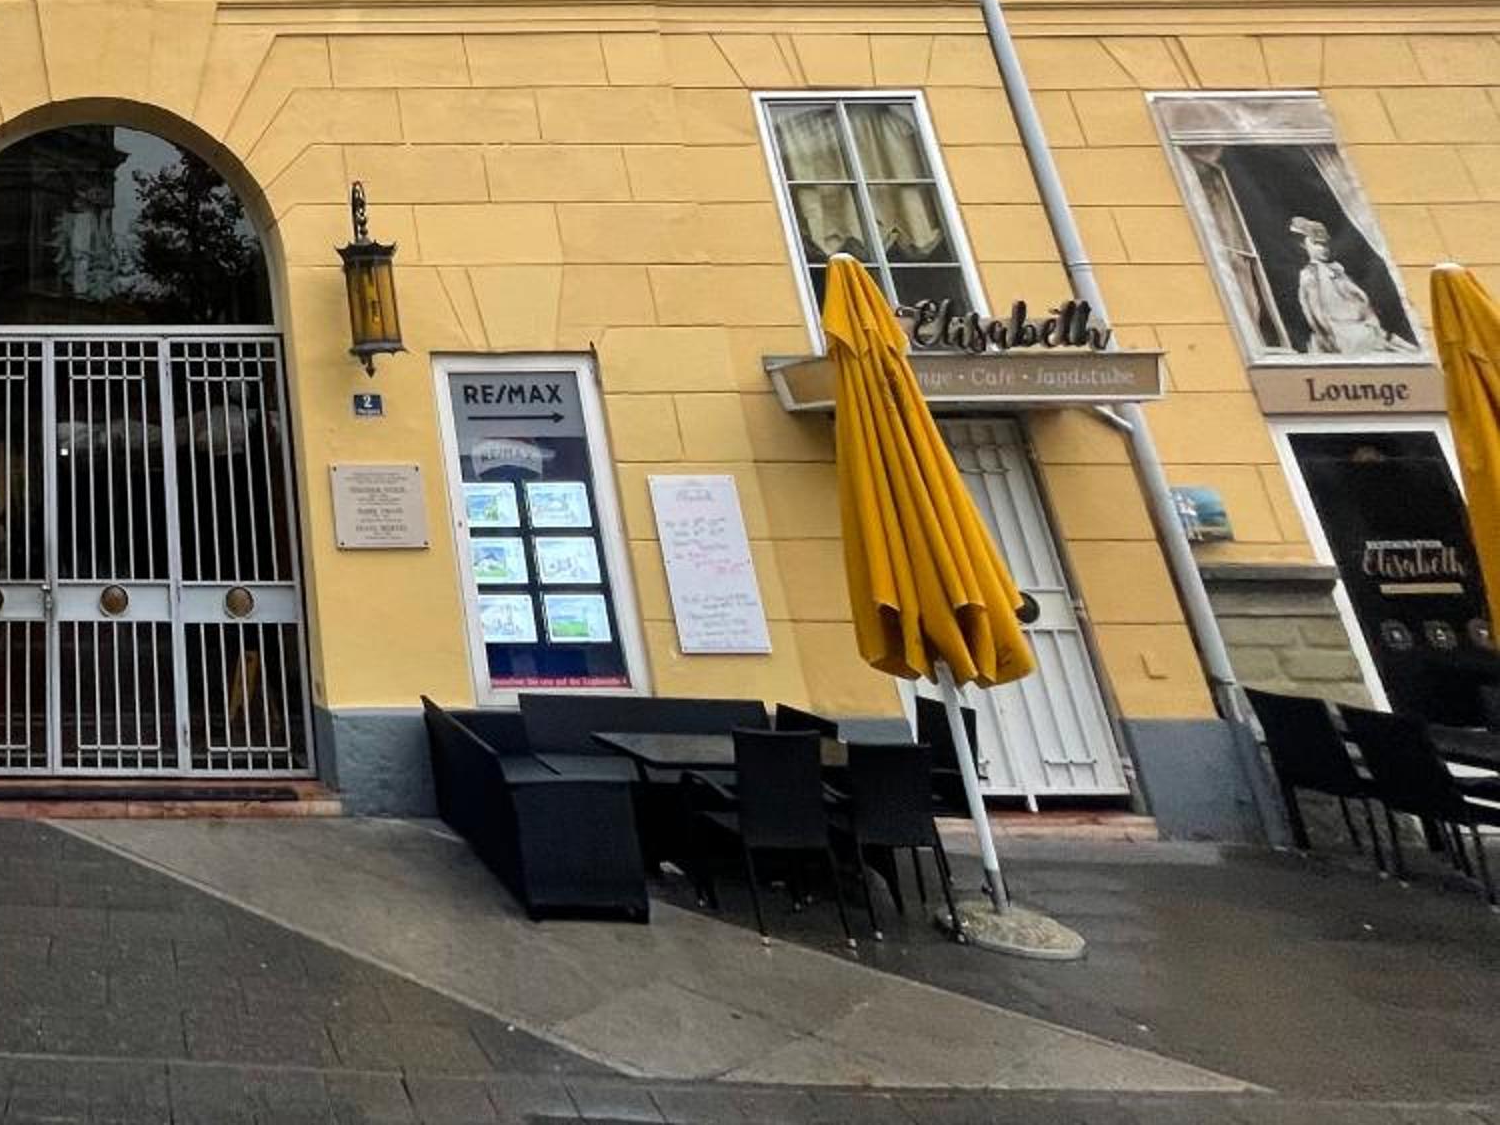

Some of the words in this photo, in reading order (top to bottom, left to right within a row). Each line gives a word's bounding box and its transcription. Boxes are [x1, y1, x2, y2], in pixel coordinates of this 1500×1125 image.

[363, 395, 373, 408] 2
[463, 384, 563, 406] RE/MAX
[1305, 378, 1410, 404] Lounge
